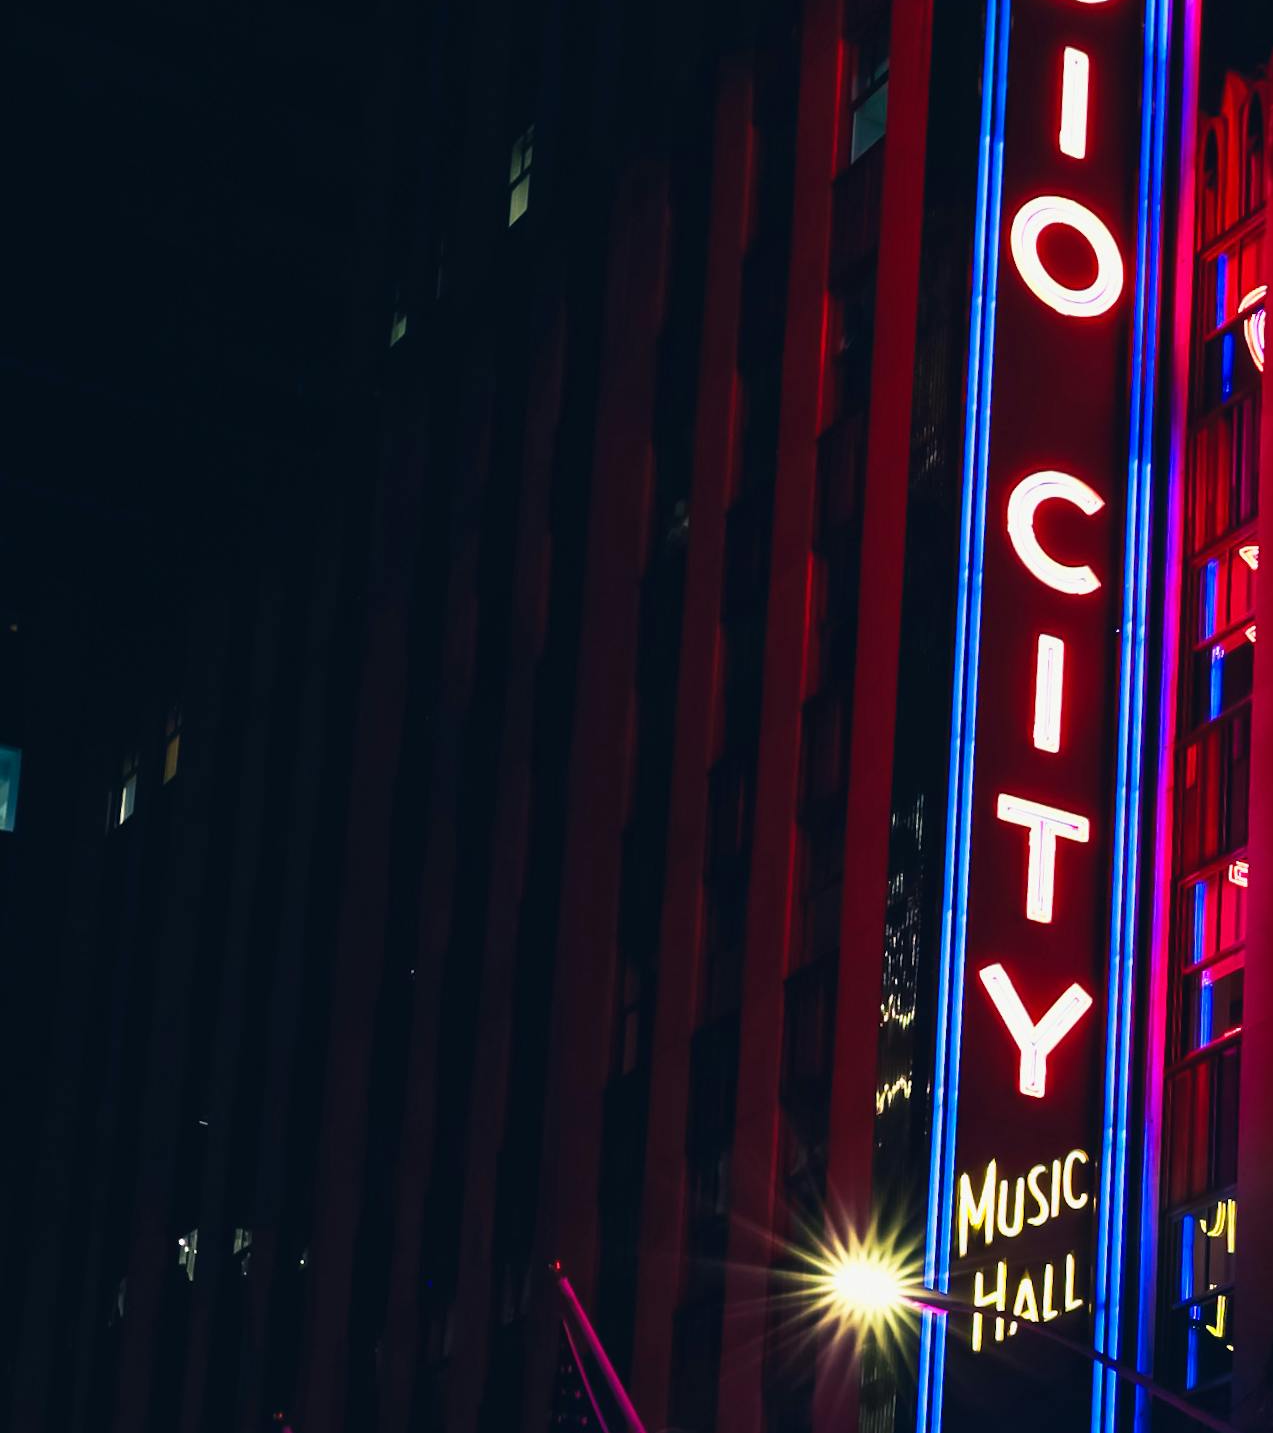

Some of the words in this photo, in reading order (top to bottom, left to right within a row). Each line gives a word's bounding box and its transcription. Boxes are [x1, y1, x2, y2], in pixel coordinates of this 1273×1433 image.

[979, 470, 1106, 1099] CITY
[957, 1148, 1091, 1258] MUSIC
[971, 1250, 1083, 1353] HALL
